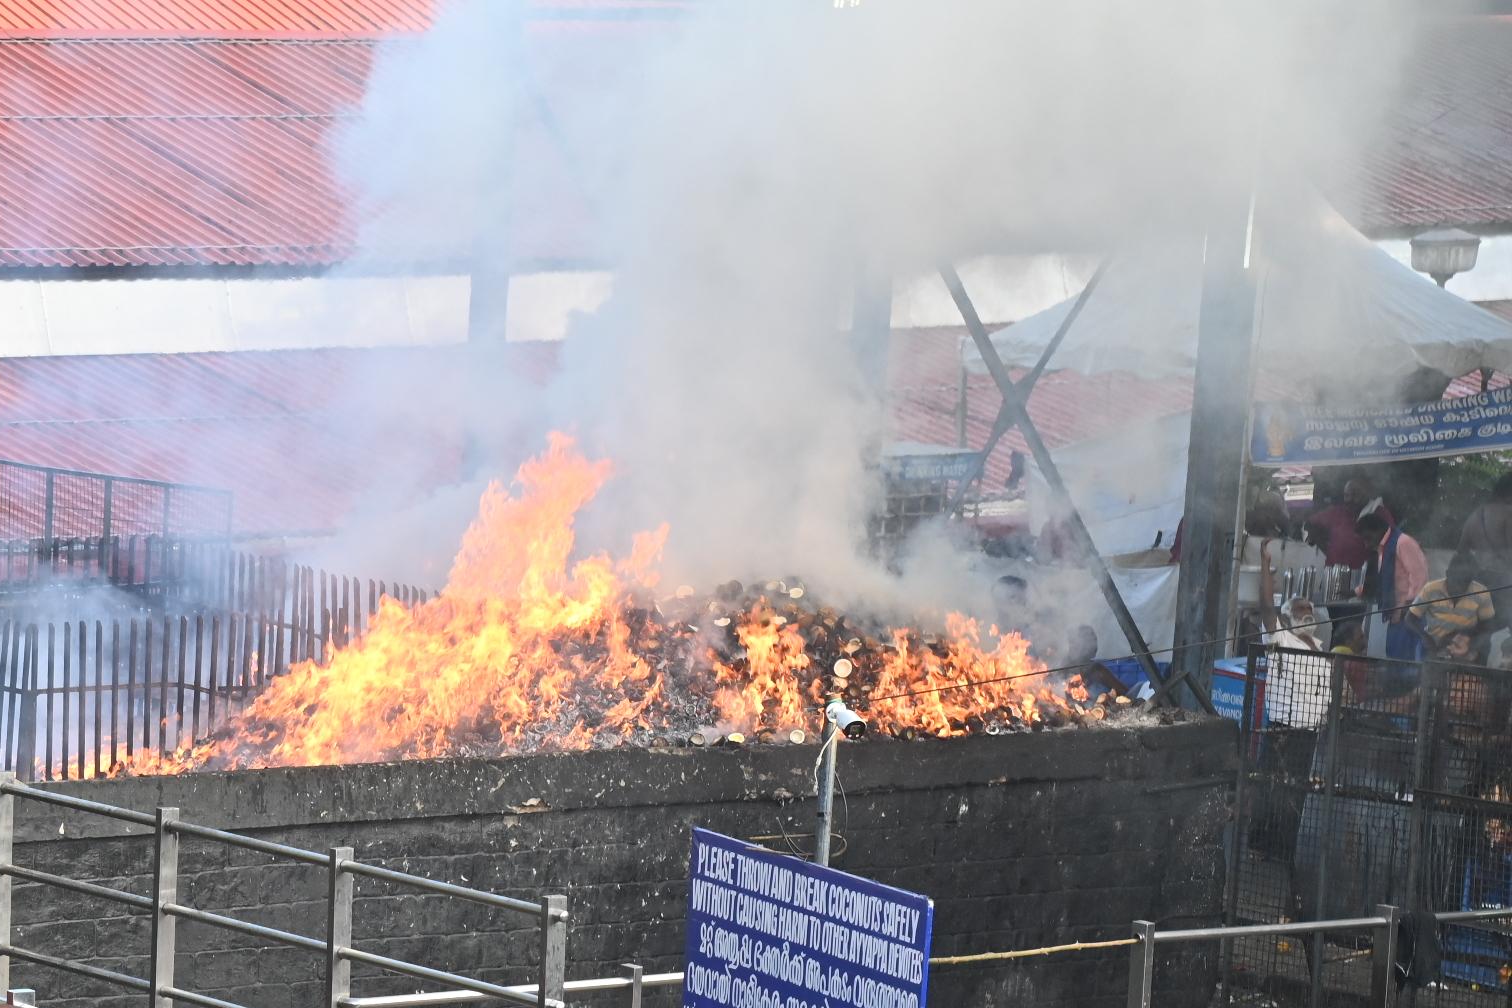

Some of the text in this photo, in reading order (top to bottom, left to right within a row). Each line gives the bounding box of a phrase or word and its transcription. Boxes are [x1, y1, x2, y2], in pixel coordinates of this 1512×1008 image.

[692, 877, 737, 922] WITHOUT
[735, 892, 778, 937] CAUSING
[777, 906, 809, 947] HARM
[809, 915, 822, 951] TO
[821, 920, 850, 961] OTHER
[848, 929, 889, 974] AYYAPPA
[697, 842, 921, 944] PLEASE THROW AND BREAK COCONUTS SAFELY
[686, 961, 734, 1004] ദയവായി
